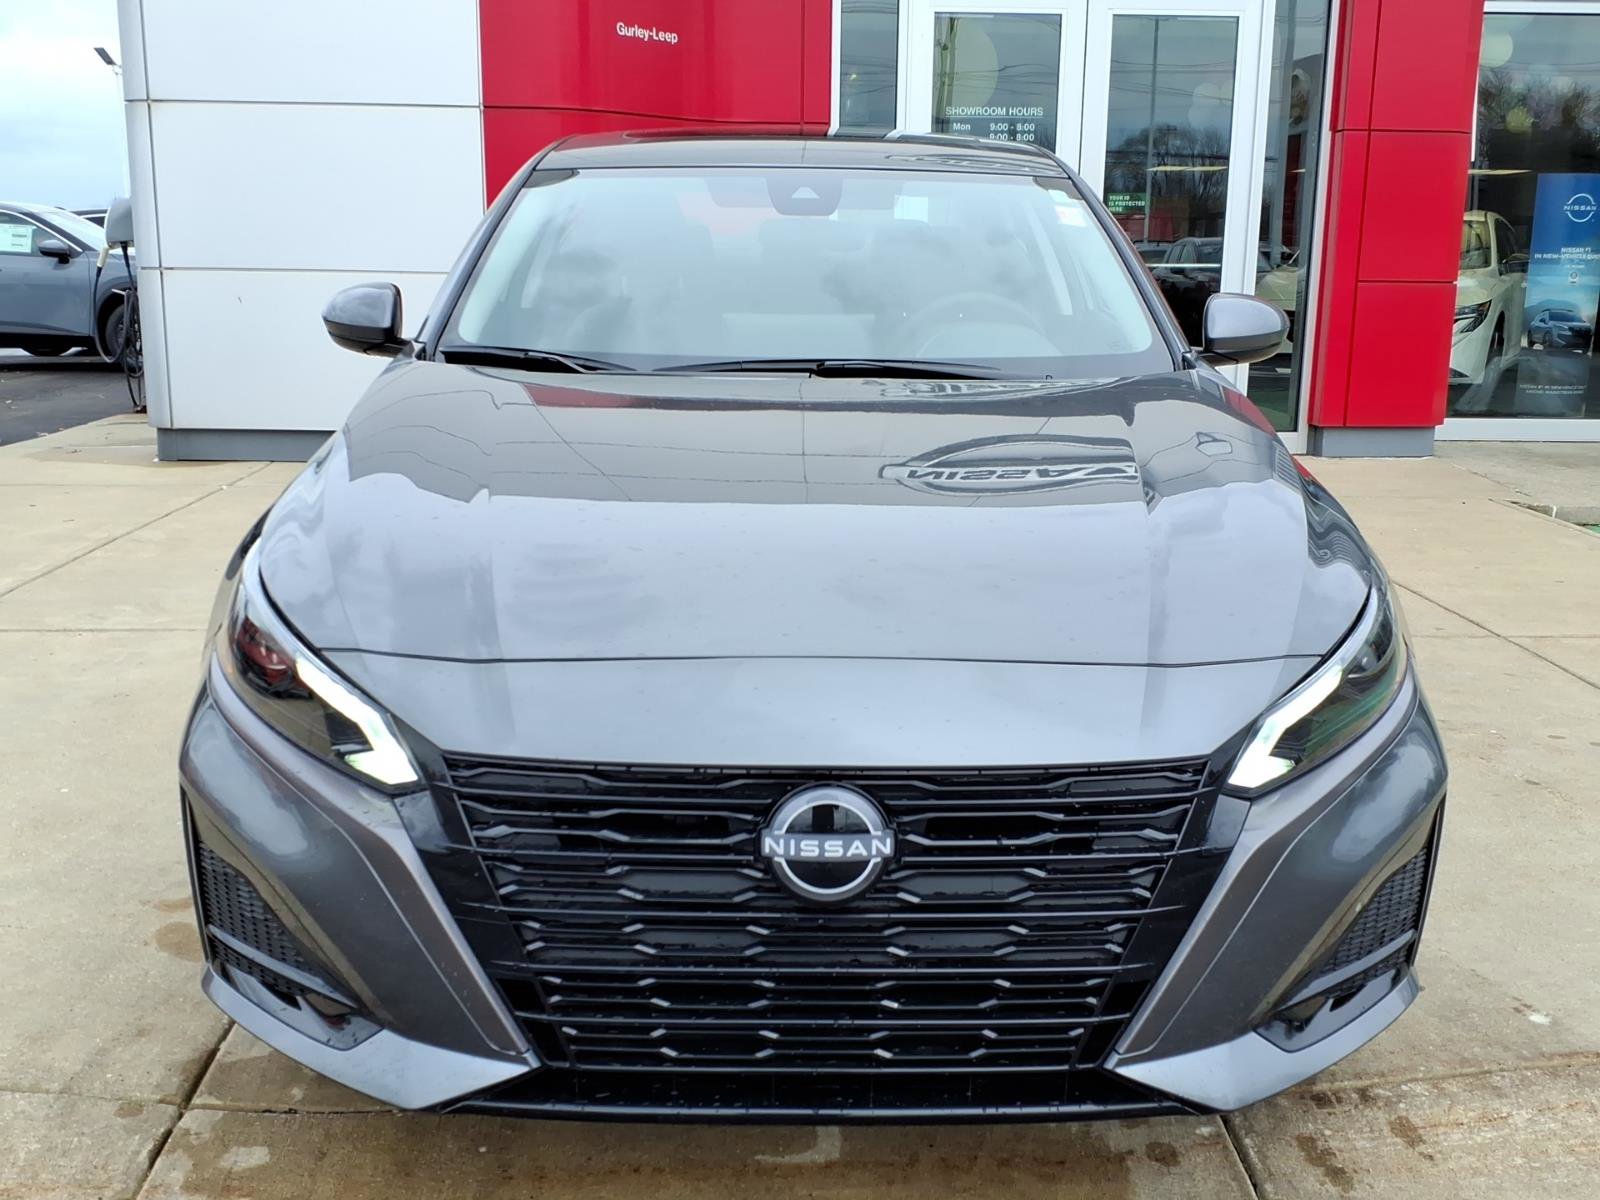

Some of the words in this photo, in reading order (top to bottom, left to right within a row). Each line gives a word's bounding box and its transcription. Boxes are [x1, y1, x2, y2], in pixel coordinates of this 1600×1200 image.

[616, 22, 678, 45] Gurley-Leep
[945, 106, 1006, 116] SHOWROOM
[1009, 107, 1044, 116] HOURS
[953, 123, 971, 131] Mon
[990, 123, 1009, 131] 9:00
[1016, 123, 1035, 131] 8:00
[764, 836, 891, 858] NISSAN
